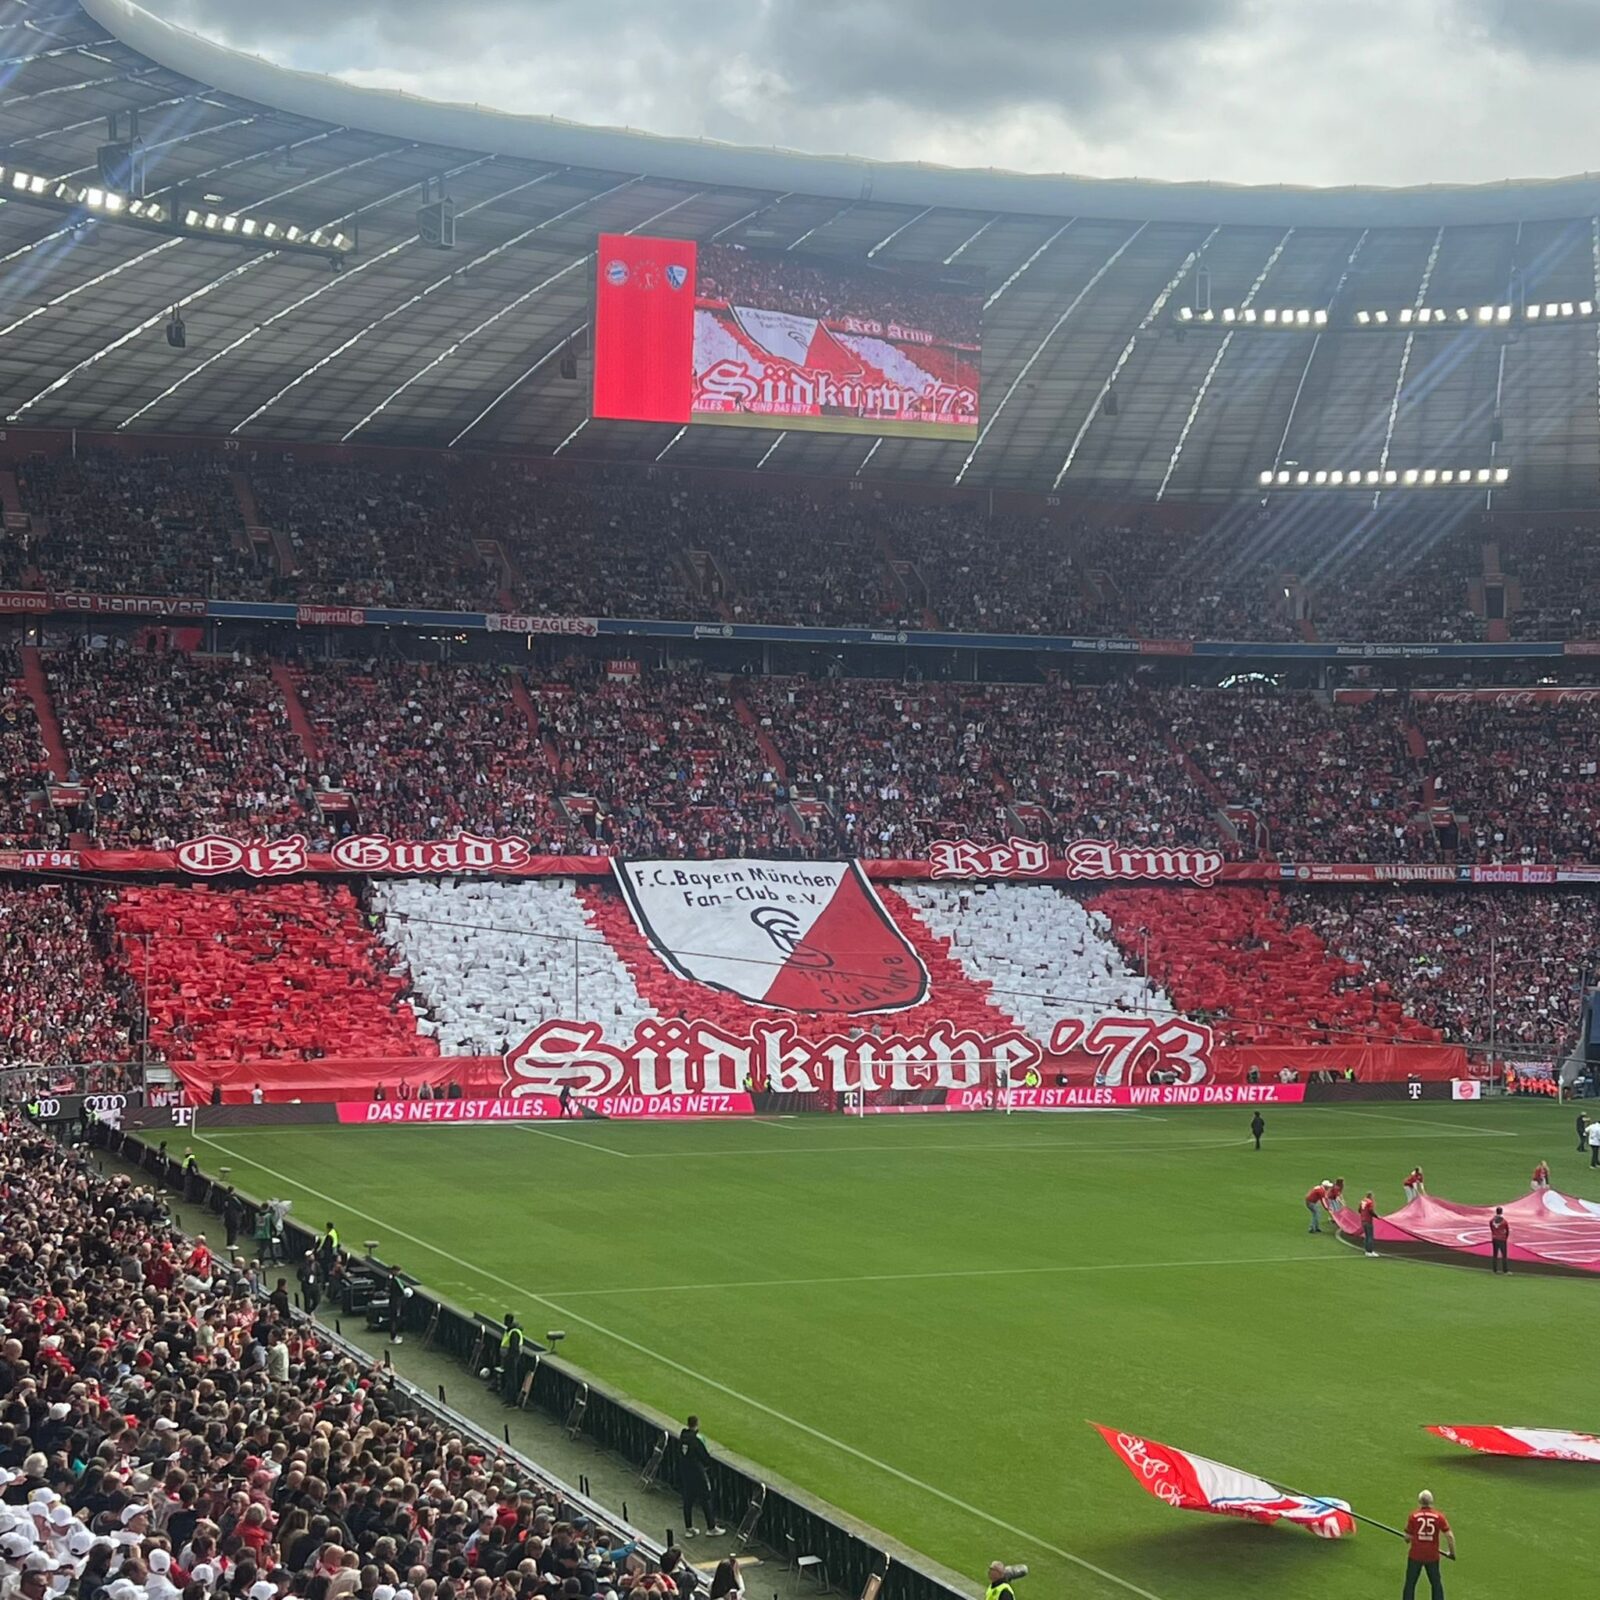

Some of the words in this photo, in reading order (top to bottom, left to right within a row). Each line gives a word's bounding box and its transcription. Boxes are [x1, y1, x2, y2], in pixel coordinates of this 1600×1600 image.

[701, 362, 919, 411] Südkurve
[300, 607, 350, 625] Wippertal
[500, 618, 528, 630] RED
[531, 619, 585, 632] EAGLES
[50, 853, 72, 867] 94
[932, 839, 1047, 875] Red
[1067, 839, 1221, 884] Army
[747, 867, 837, 888] München
[1473, 866, 1519, 882] Brechen
[683, 884, 779, 907] Fan-Club
[510, 1026, 1036, 1098] Südkurve
[961, 1090, 993, 1105] DAS
[997, 1089, 1038, 1106] NETZ
[1039, 1089, 1065, 1105] IST
[1065, 1088, 1117, 1105] ALLES.
[1129, 1087, 1160, 1103] WIR
[1163, 1086, 1200, 1103] SIND
[1203, 1086, 1234, 1102] DAS
[1236, 1085, 1279, 1101] NETZ.
[367, 1102, 404, 1120] DAS
[408, 1101, 453, 1120] NETZ
[458, 1100, 488, 1118] IST
[489, 1099, 548, 1117] ALLES.
[602, 1097, 645, 1114] SIND
[647, 1096, 683, 1113] DAS
[685, 1095, 734, 1113] NETZ.
[1416, 1517, 1436, 1536] 25
